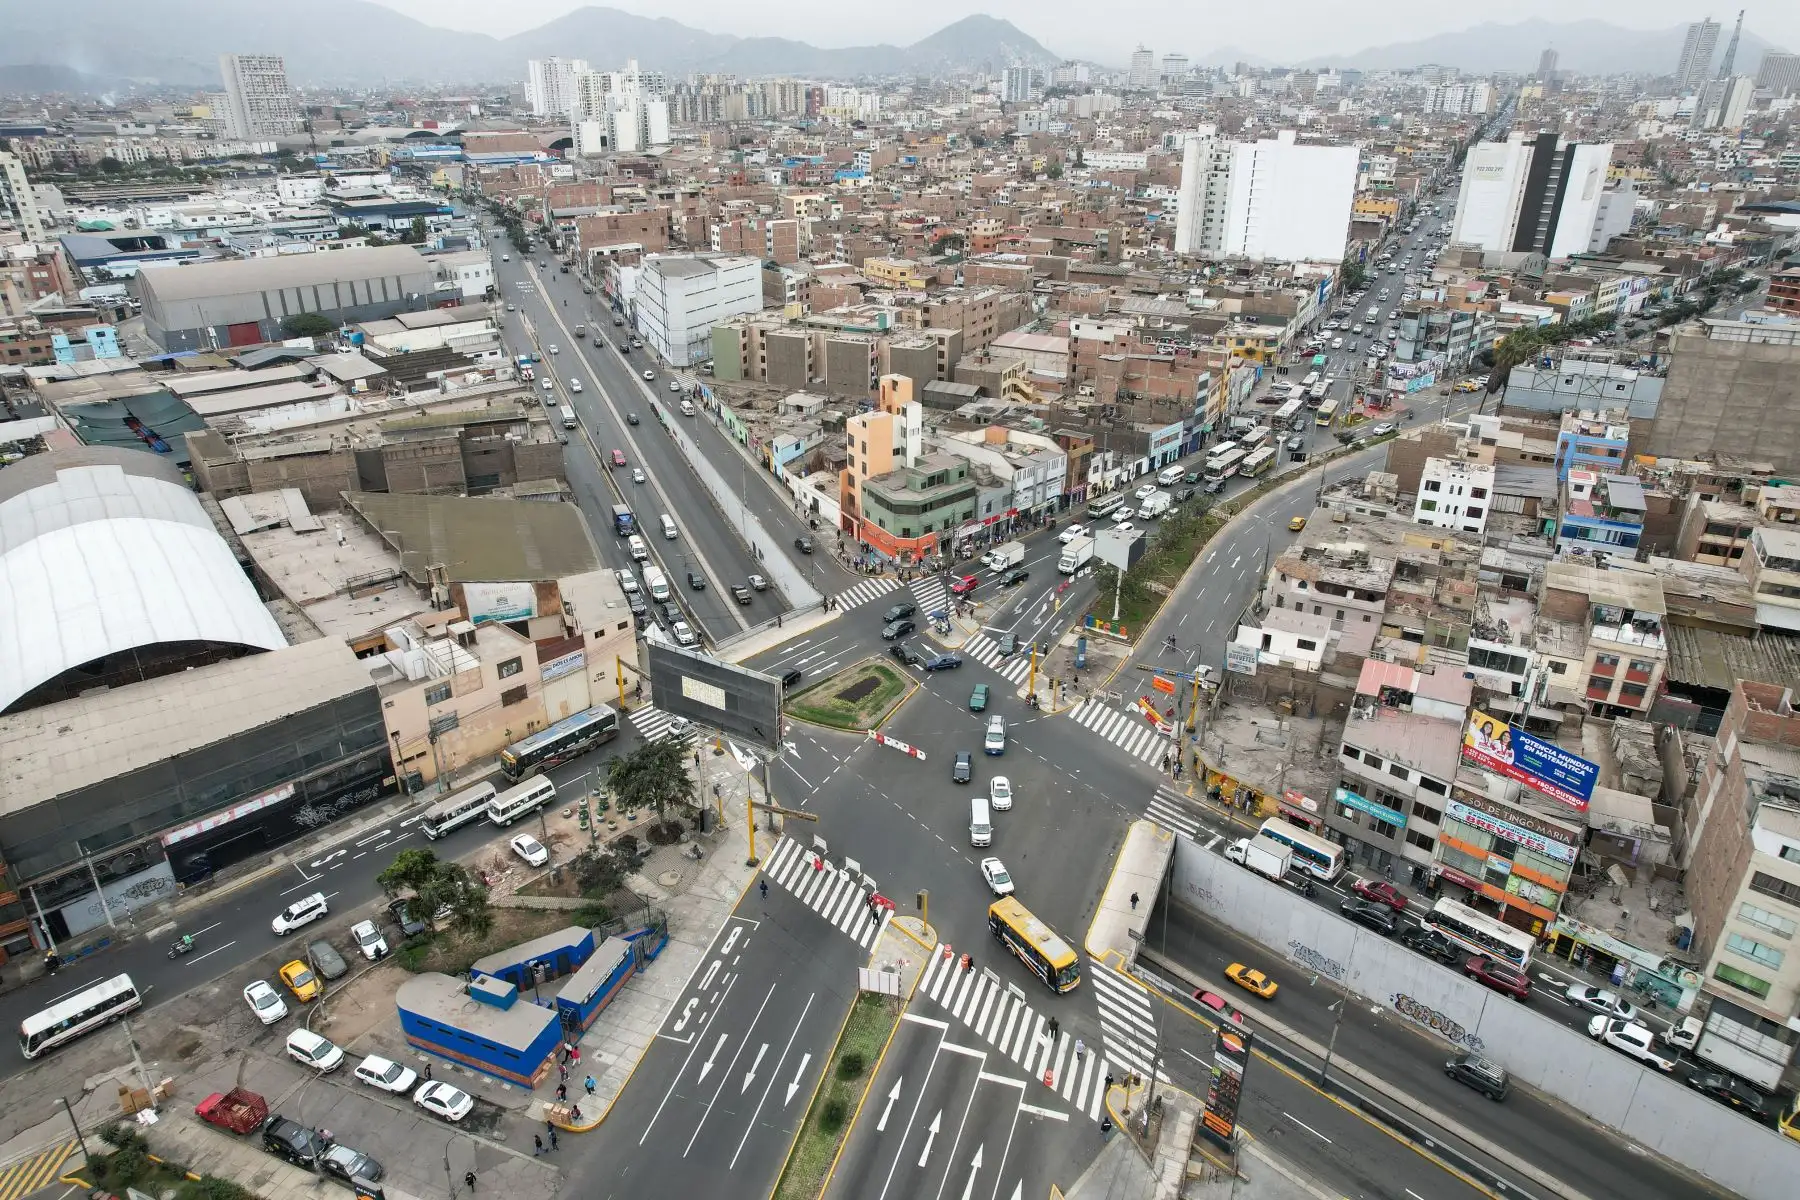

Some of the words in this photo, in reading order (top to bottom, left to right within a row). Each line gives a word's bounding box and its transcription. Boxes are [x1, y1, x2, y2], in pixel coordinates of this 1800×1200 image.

[1520, 736, 1558, 756] POTENCIA
[1558, 753, 1594, 774] MUNDIAL
[1524, 745, 1535, 753] EN
[1534, 749, 1586, 777] MATEMÁTICA
[1555, 789, 1585, 806] OLIVEROS
[1465, 815, 1547, 851] BREVETES
[1468, 797, 1486, 811] SOL
[1488, 804, 1501, 816] DE
[1504, 811, 1535, 827] TINGO
[1536, 825, 1570, 844] MARIA
[673, 926, 743, 1032] BUS
[1222, 1023, 1247, 1040] REPSOL
